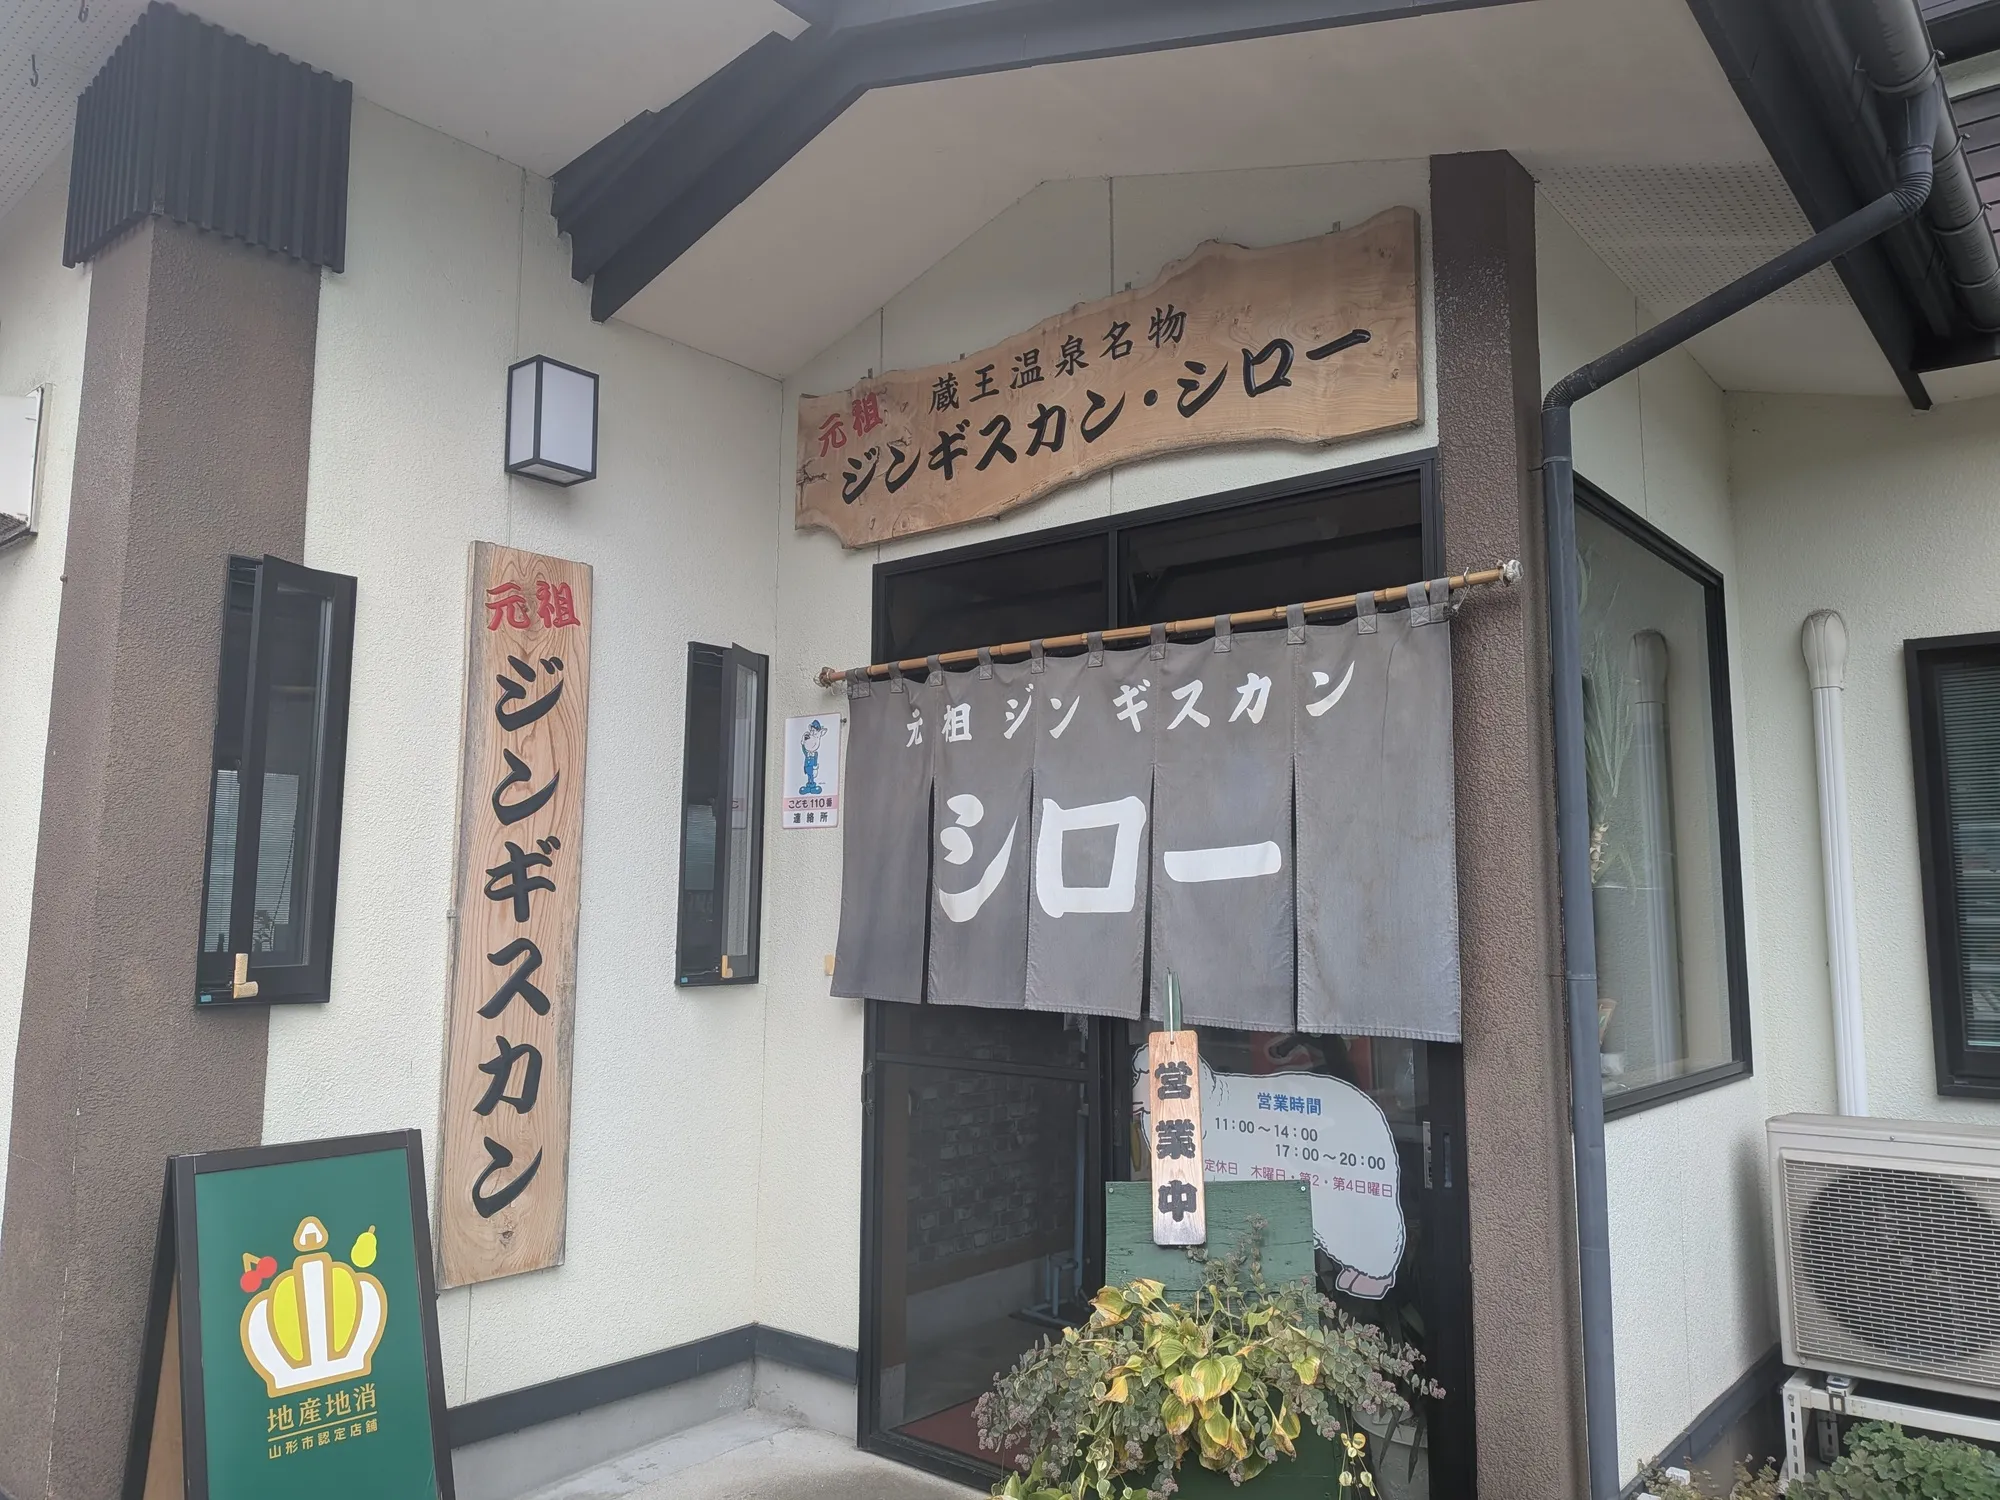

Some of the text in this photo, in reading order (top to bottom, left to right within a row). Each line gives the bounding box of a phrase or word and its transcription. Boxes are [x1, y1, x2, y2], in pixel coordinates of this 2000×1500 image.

[928, 305, 1188, 415] 蔵王温泉名物
[818, 392, 884, 458] 元祖
[842, 328, 1372, 504] ジンギスカン・シロー
[485, 581, 581, 631] 元祖
[788, 797, 833, 809] こども110番
[793, 812, 828, 824] 連絡所
[938, 794, 1282, 923] シロー
[472, 655, 565, 1219] ジンギスカン
[1257, 1092, 1322, 1116] 営業時間
[1155, 1061, 1198, 1222] 営業中
[1204, 1159, 1238, 1176] 定休日
[267, 1383, 377, 1433] 地産地消
[268, 1418, 378, 1459] 山形市認定店舗
